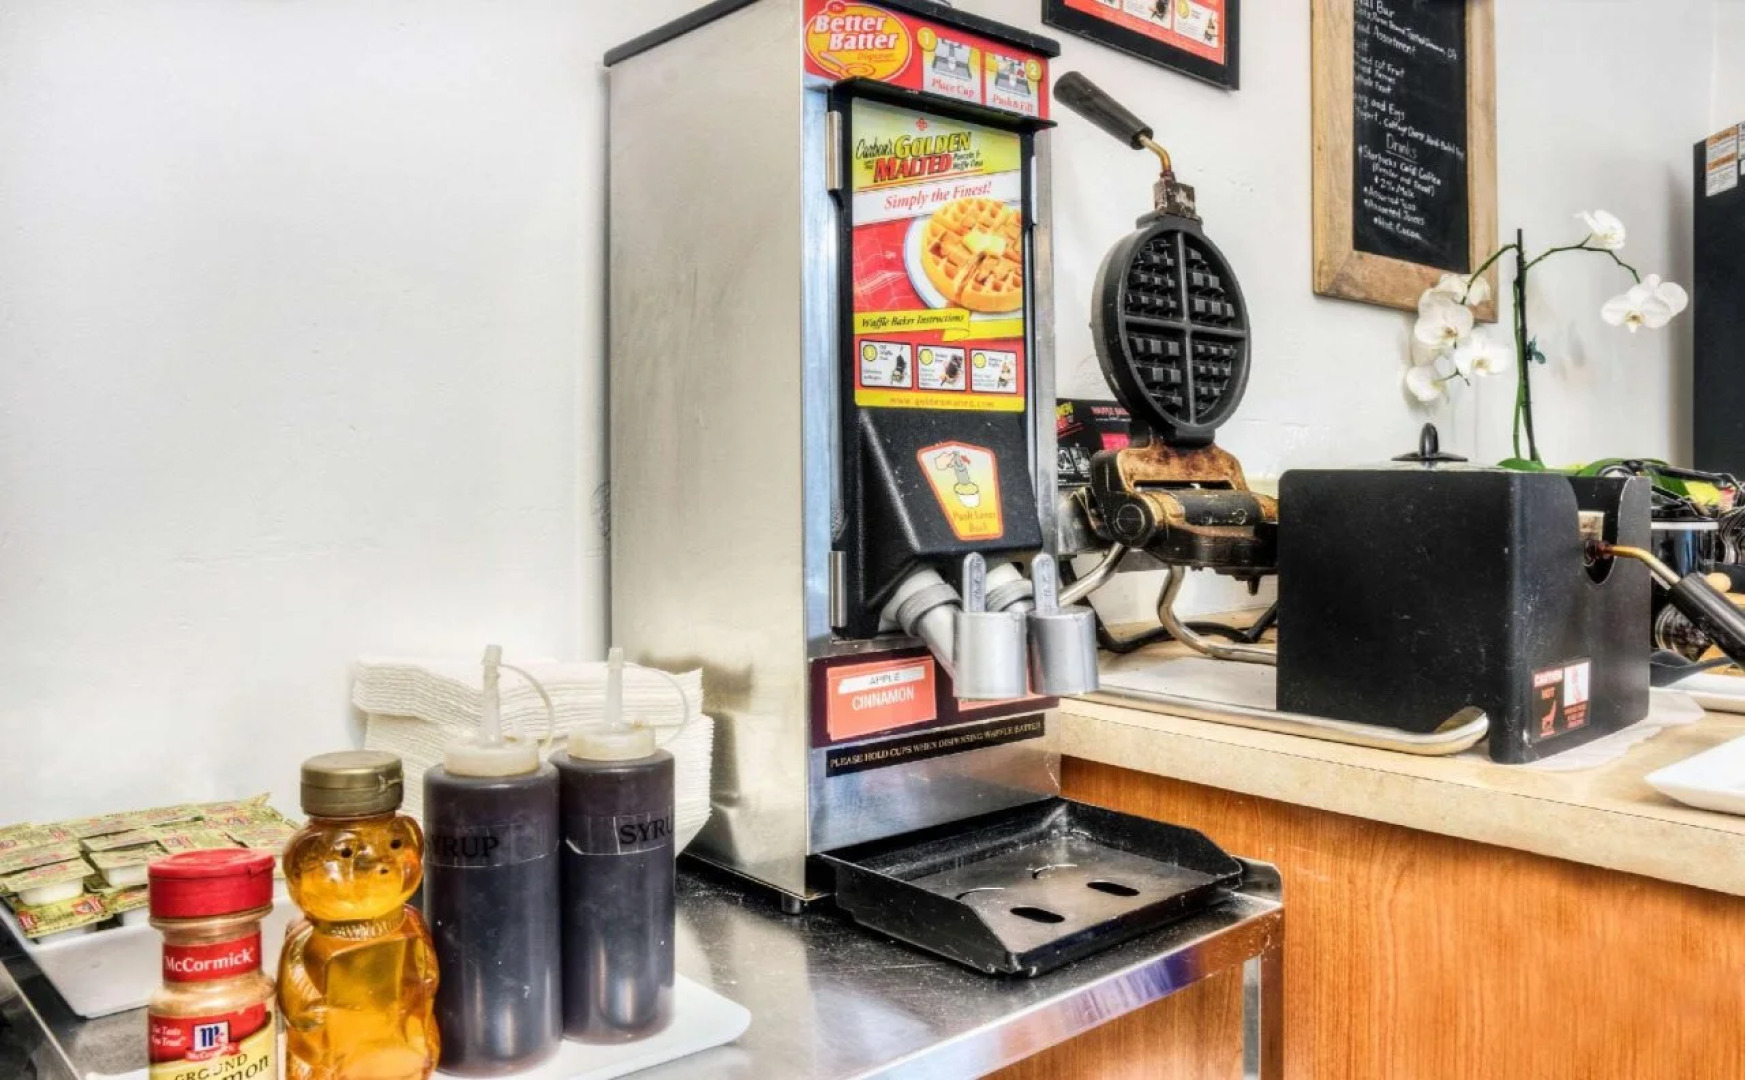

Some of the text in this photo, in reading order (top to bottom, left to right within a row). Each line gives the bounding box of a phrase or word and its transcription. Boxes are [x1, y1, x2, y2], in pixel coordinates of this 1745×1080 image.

[814, 14, 886, 34] Better
[828, 32, 899, 51] Batter
[956, 85, 974, 98] Cup
[894, 132, 971, 158] GOLDEN
[874, 153, 952, 182] MALTED
[884, 181, 992, 210] Simply the Finest!
[862, 314, 964, 330] Waffle Baker Instructions
[869, 672, 901, 685] APPLE
[852, 686, 915, 711] CINNAMON
[829, 722, 1041, 768] PLEASE HOLD CUPS WHEN DISPENSING WAFFLE BATTER
[620, 816, 673, 845] SYRU
[164, 948, 253, 972] McCormick
